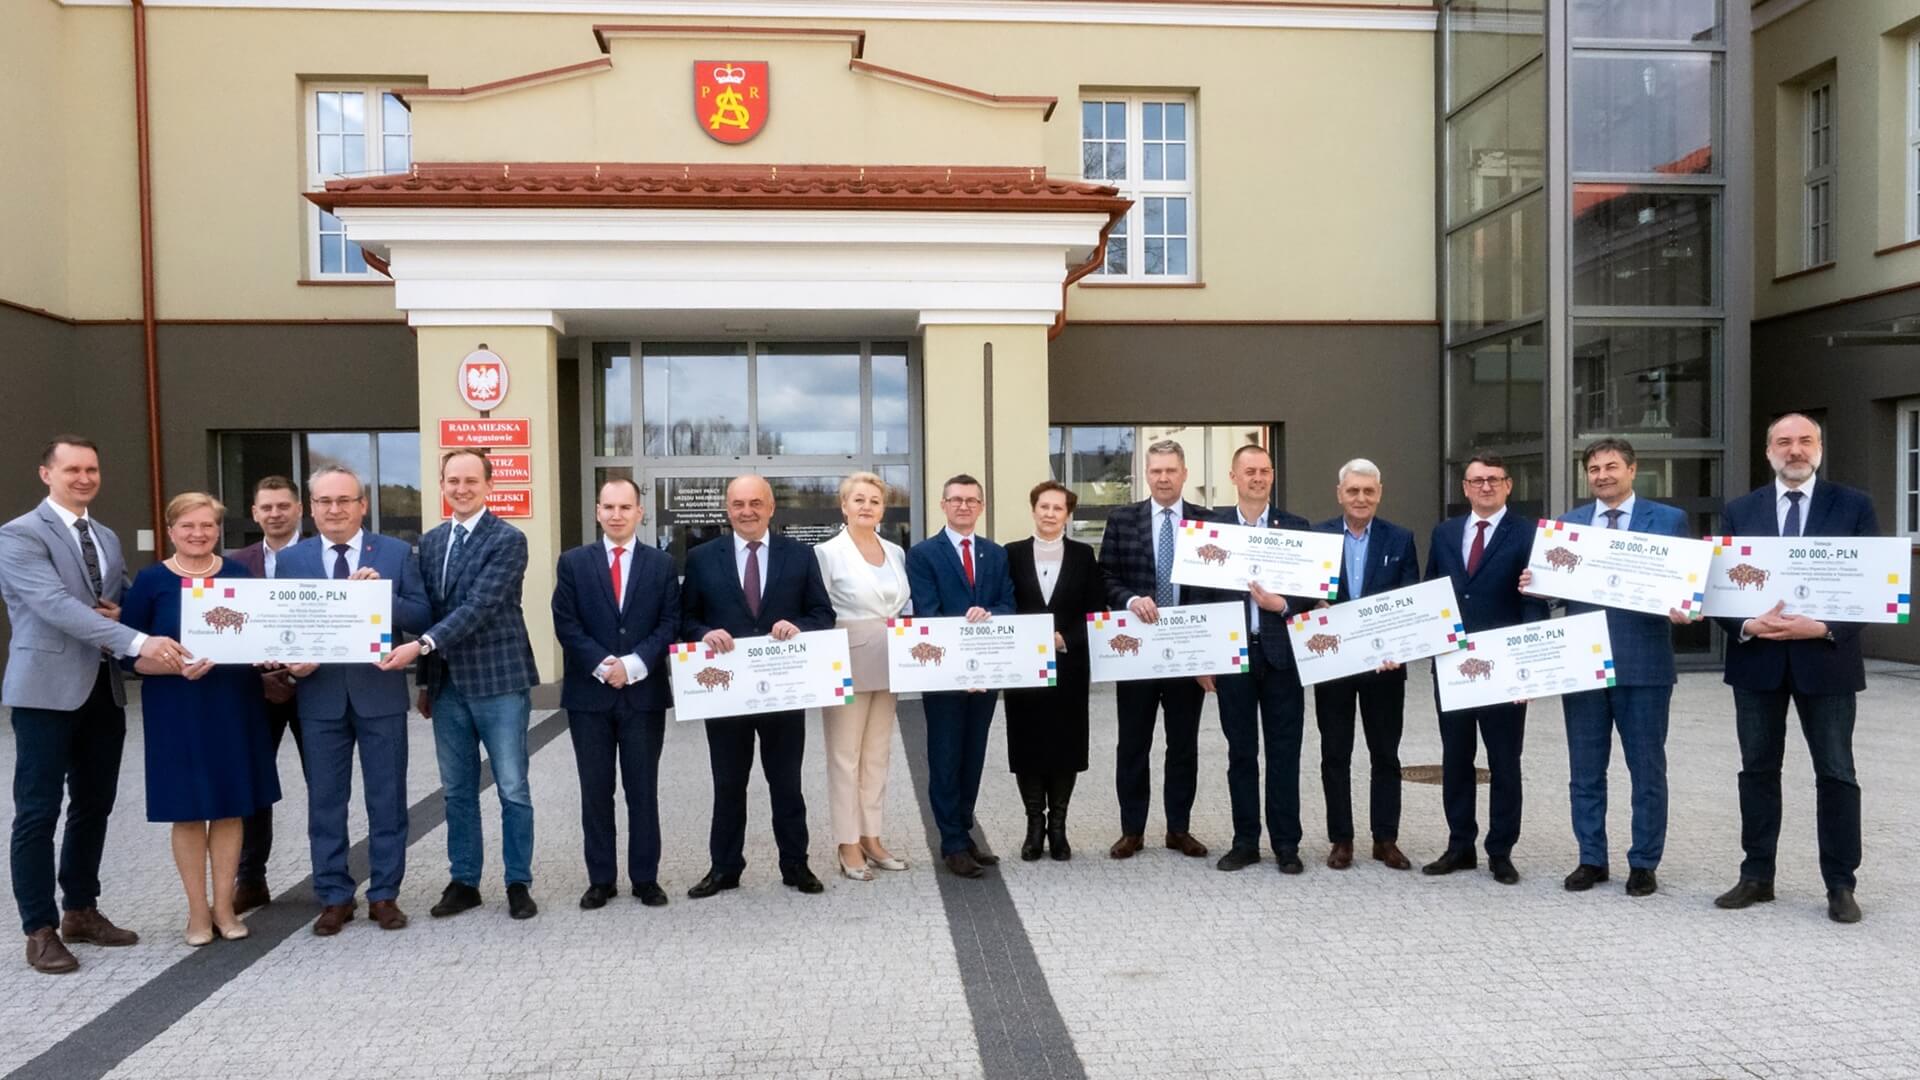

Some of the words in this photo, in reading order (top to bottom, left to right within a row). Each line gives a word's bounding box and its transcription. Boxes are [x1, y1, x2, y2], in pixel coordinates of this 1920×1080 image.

[702, 86, 711, 98] P
[749, 86, 760, 98] R
[448, 424, 476, 432] RADA
[478, 424, 520, 432] MIEJSKA
[466, 434, 513, 444] Augustowie
[1248, 536, 1262, 544] 300
[1285, 538, 1303, 548] PLN
[1609, 540, 1626, 550] 280
[1649, 545, 1669, 556] PLN
[1788, 548, 1806, 559] 200
[1809, 548, 1834, 560] 000,-
[1836, 548, 1858, 559] PLN
[270, 591, 276, 600] 2
[278, 591, 296, 600] 000
[299, 591, 323, 601] 000,-
[326, 591, 347, 600] PLN
[1358, 606, 1373, 618] 300
[1396, 596, 1414, 609] PLN
[1190, 614, 1207, 623] PLN
[960, 626, 974, 636] 750
[997, 625, 1015, 635] PLN
[1506, 636, 1522, 646] 200
[1546, 628, 1565, 639] PLN
[747, 647, 763, 657] 500
[788, 642, 806, 654] PLN
